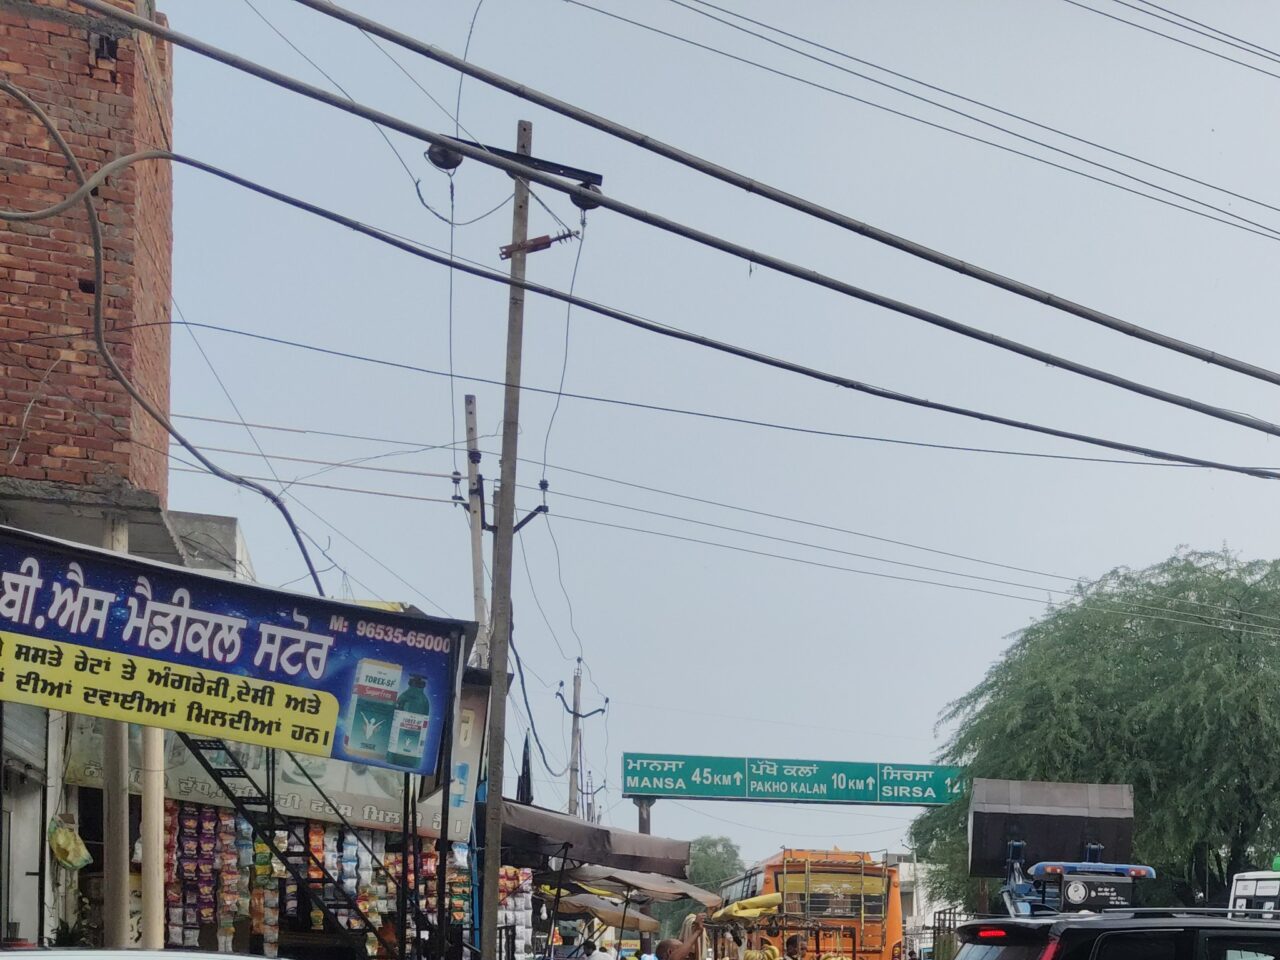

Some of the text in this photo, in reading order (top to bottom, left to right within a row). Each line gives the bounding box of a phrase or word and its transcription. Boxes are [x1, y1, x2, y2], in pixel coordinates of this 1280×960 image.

[122, 576, 248, 663] ਮੈਡੀਕਲ
[254, 607, 334, 679] ਸਟੋਰ
[356, 620, 451, 654] 96535-65000
[15, 644, 63, 668] ਸਸਤੇ
[74, 650, 111, 675] ਰੇਟਾਂ
[121, 659, 137, 680] ਤੇ
[285, 694, 322, 715] ਅਤੇ
[16, 671, 72, 698] ਦੀਆਂ
[83, 686, 176, 717] ਦਵਾਈਆਂ
[187, 701, 282, 736] ਮਿਲਦੀਆਂ
[627, 759, 685, 772] ਮਾਨਸਾ
[882, 766, 934, 782] ਸਿਰਸਾ
[626, 776, 686, 789] MANSA
[750, 780, 787, 793] PAKHO
[791, 782, 827, 794] KALAN
[832, 773, 847, 789] 10
[882, 785, 936, 797] SIRSA
